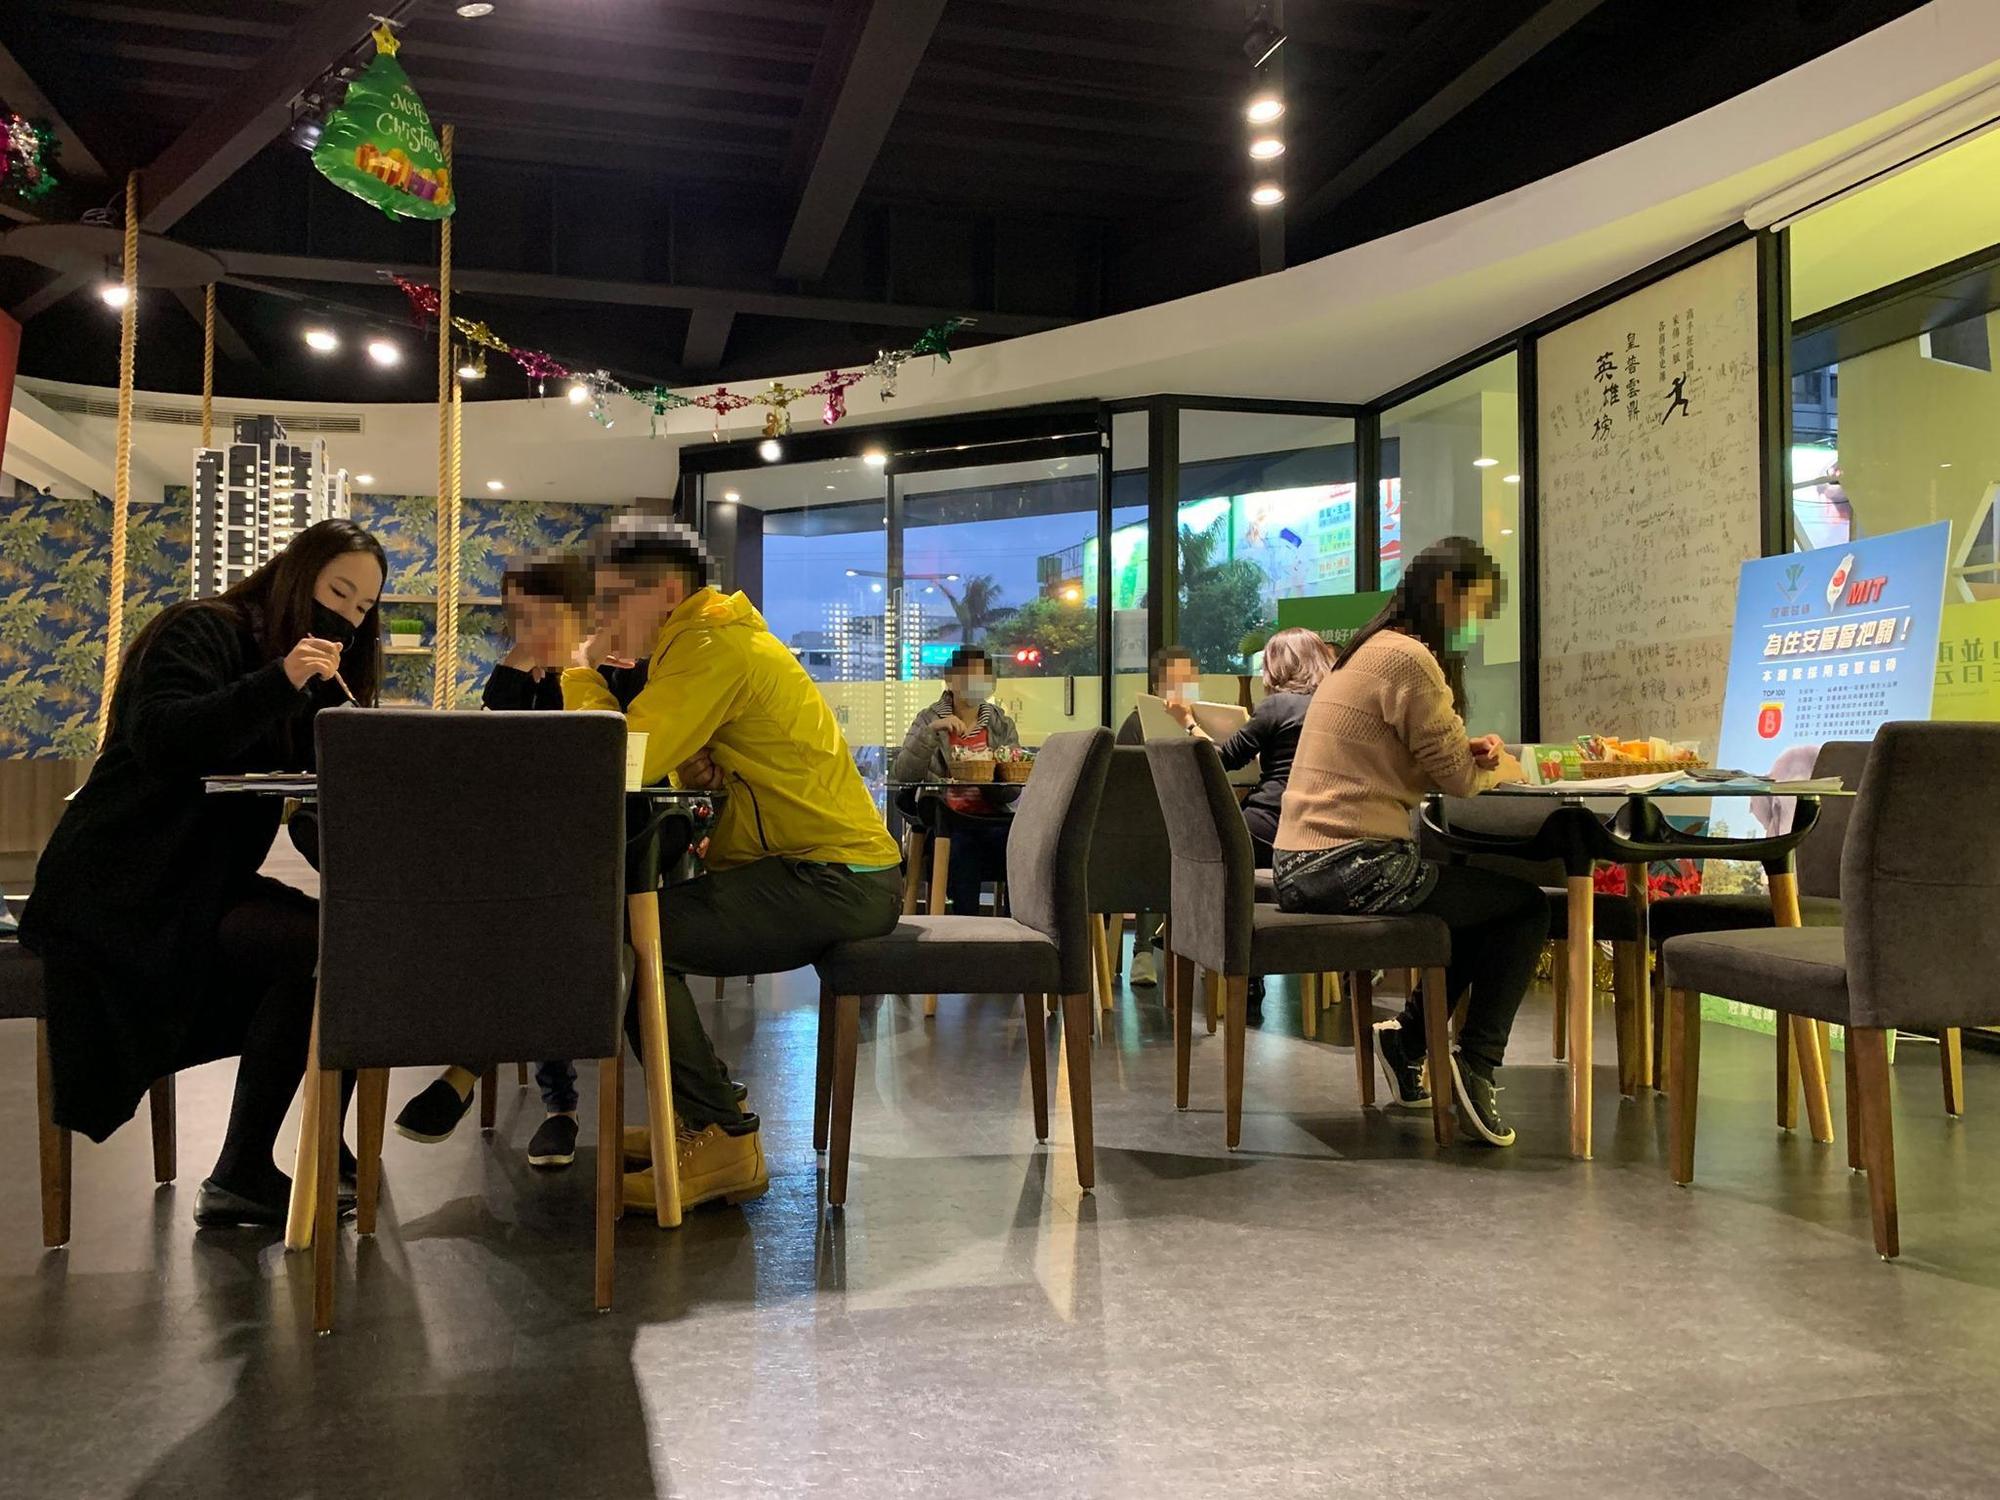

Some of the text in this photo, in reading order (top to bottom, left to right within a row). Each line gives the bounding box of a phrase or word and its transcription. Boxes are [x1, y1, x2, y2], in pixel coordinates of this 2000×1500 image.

[390, 94, 429, 124] Merry
[1591, 351, 1621, 441] 英雄榜
[1624, 332, 1641, 422] 皇普雲鼎
[1847, 576, 1888, 606] MIT
